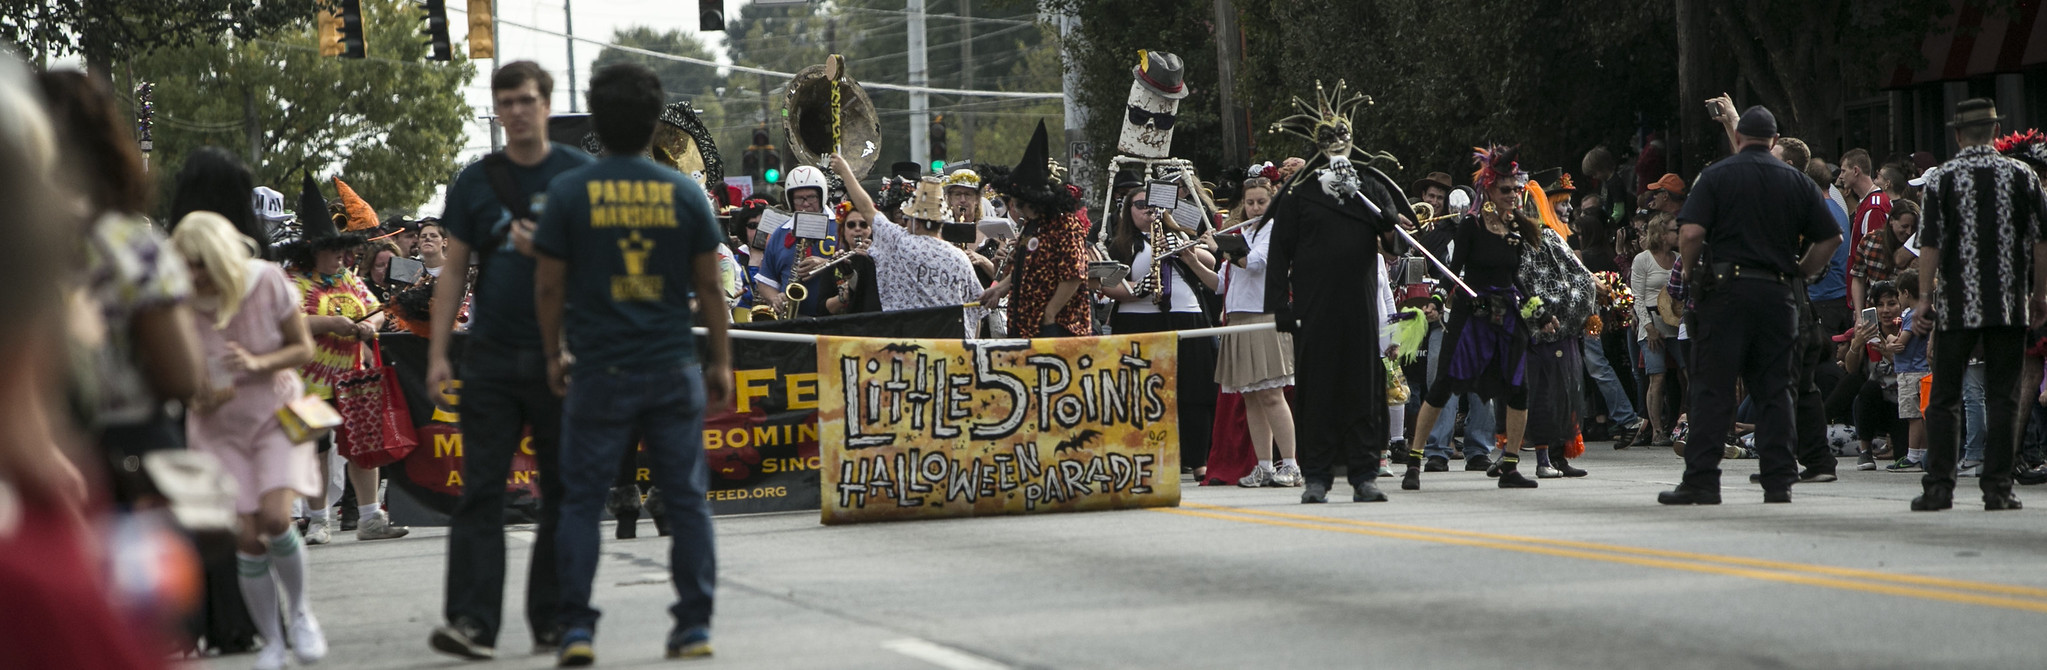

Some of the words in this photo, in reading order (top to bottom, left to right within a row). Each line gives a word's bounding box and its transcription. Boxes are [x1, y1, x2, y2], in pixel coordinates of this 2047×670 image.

[586, 178, 675, 204] PARADE
[1871, 195, 1881, 205] 11
[589, 204, 679, 228] MARSHAL
[733, 366, 819, 414] FE
[962, 338, 1032, 441] 5
[702, 422, 819, 450] BOMIN
[761, 456, 821, 473] SINC
[837, 441, 1042, 511] HALLOWEEN
[705, 486, 787, 501] FEED.ORG
